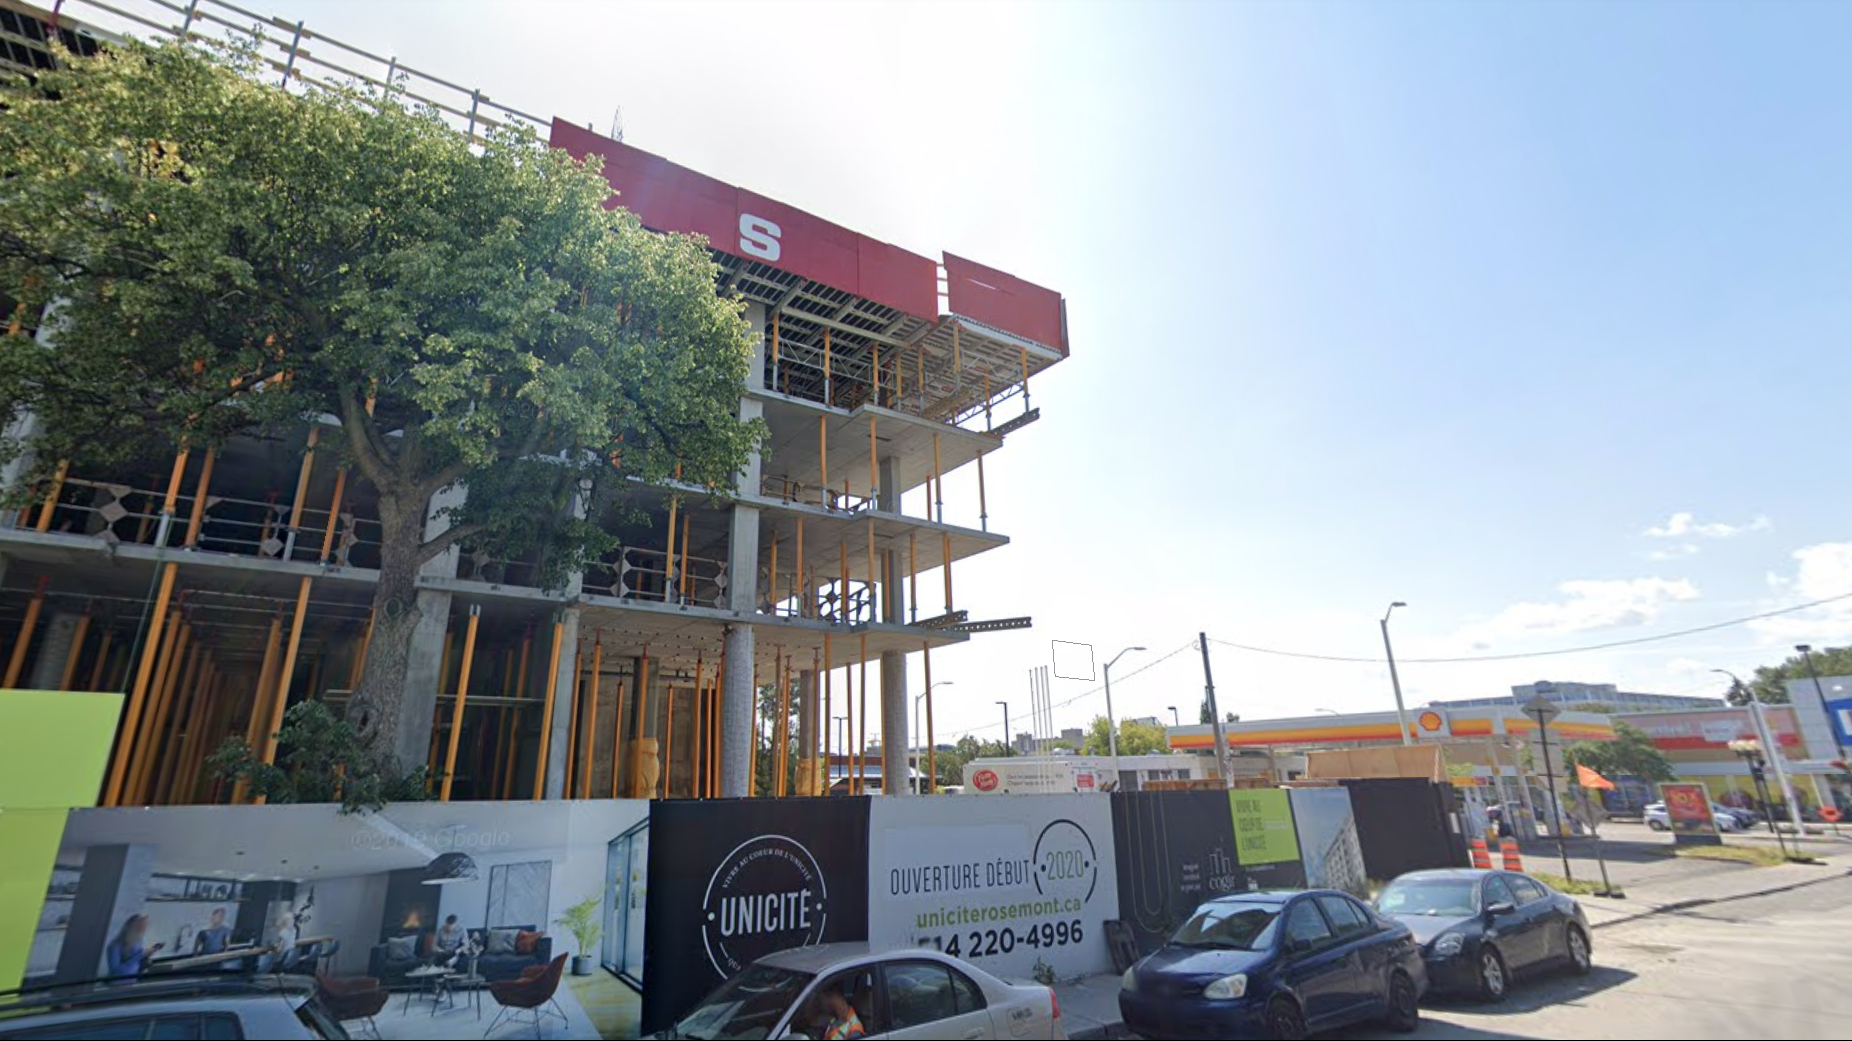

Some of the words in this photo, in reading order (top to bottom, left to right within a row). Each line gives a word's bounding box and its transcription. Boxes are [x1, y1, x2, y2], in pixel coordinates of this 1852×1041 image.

[739, 213, 781, 262] S
[739, 856, 749, 868] AU
[774, 848, 784, 857] DE
[890, 863, 981, 895] OUVERTURE
[986, 858, 1030, 887] DÉBUT
[1046, 850, 1085, 881] 2020
[720, 887, 812, 937] UNICITÉ
[916, 897, 1082, 929] uniciterosemont.ca
[968, 919, 1084, 958] 220-4996
